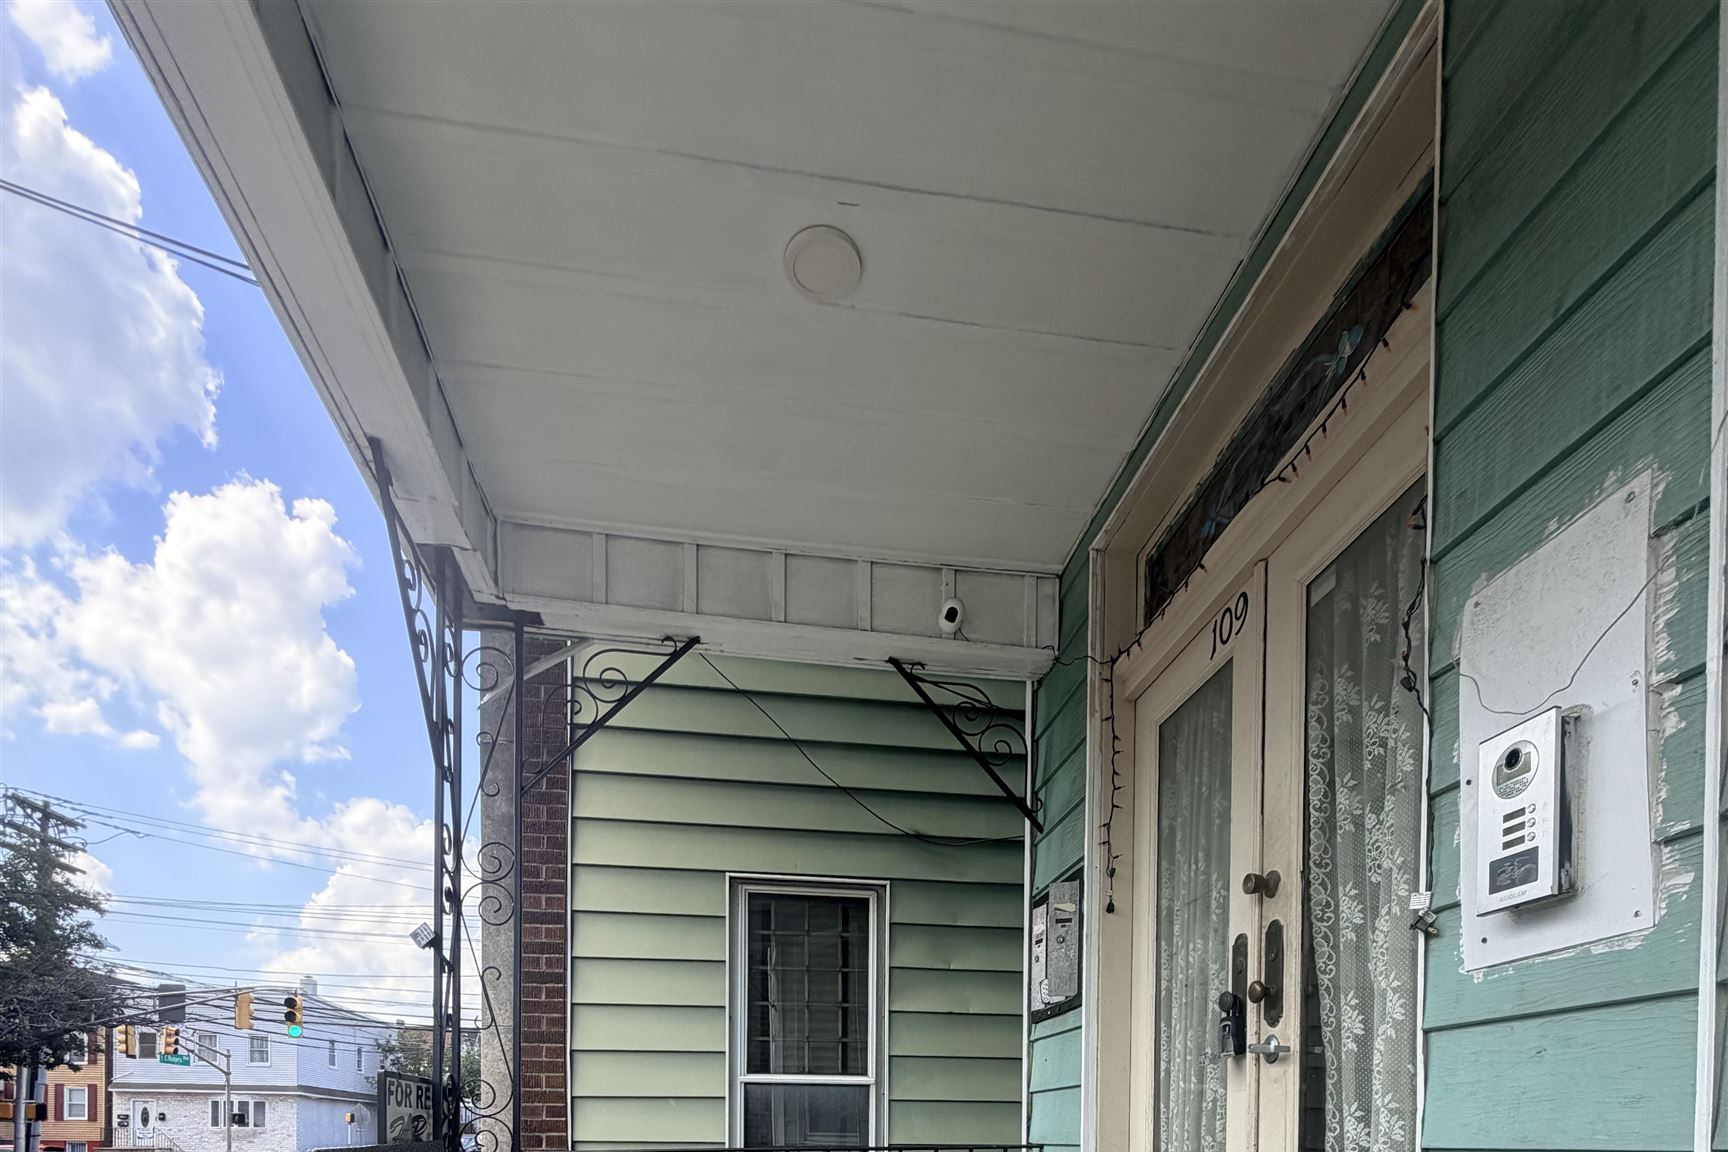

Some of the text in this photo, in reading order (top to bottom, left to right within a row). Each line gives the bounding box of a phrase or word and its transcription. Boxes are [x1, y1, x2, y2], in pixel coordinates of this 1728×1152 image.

[1210, 591, 1249, 661] 109
[387, 1079, 432, 1110] FOR RE
